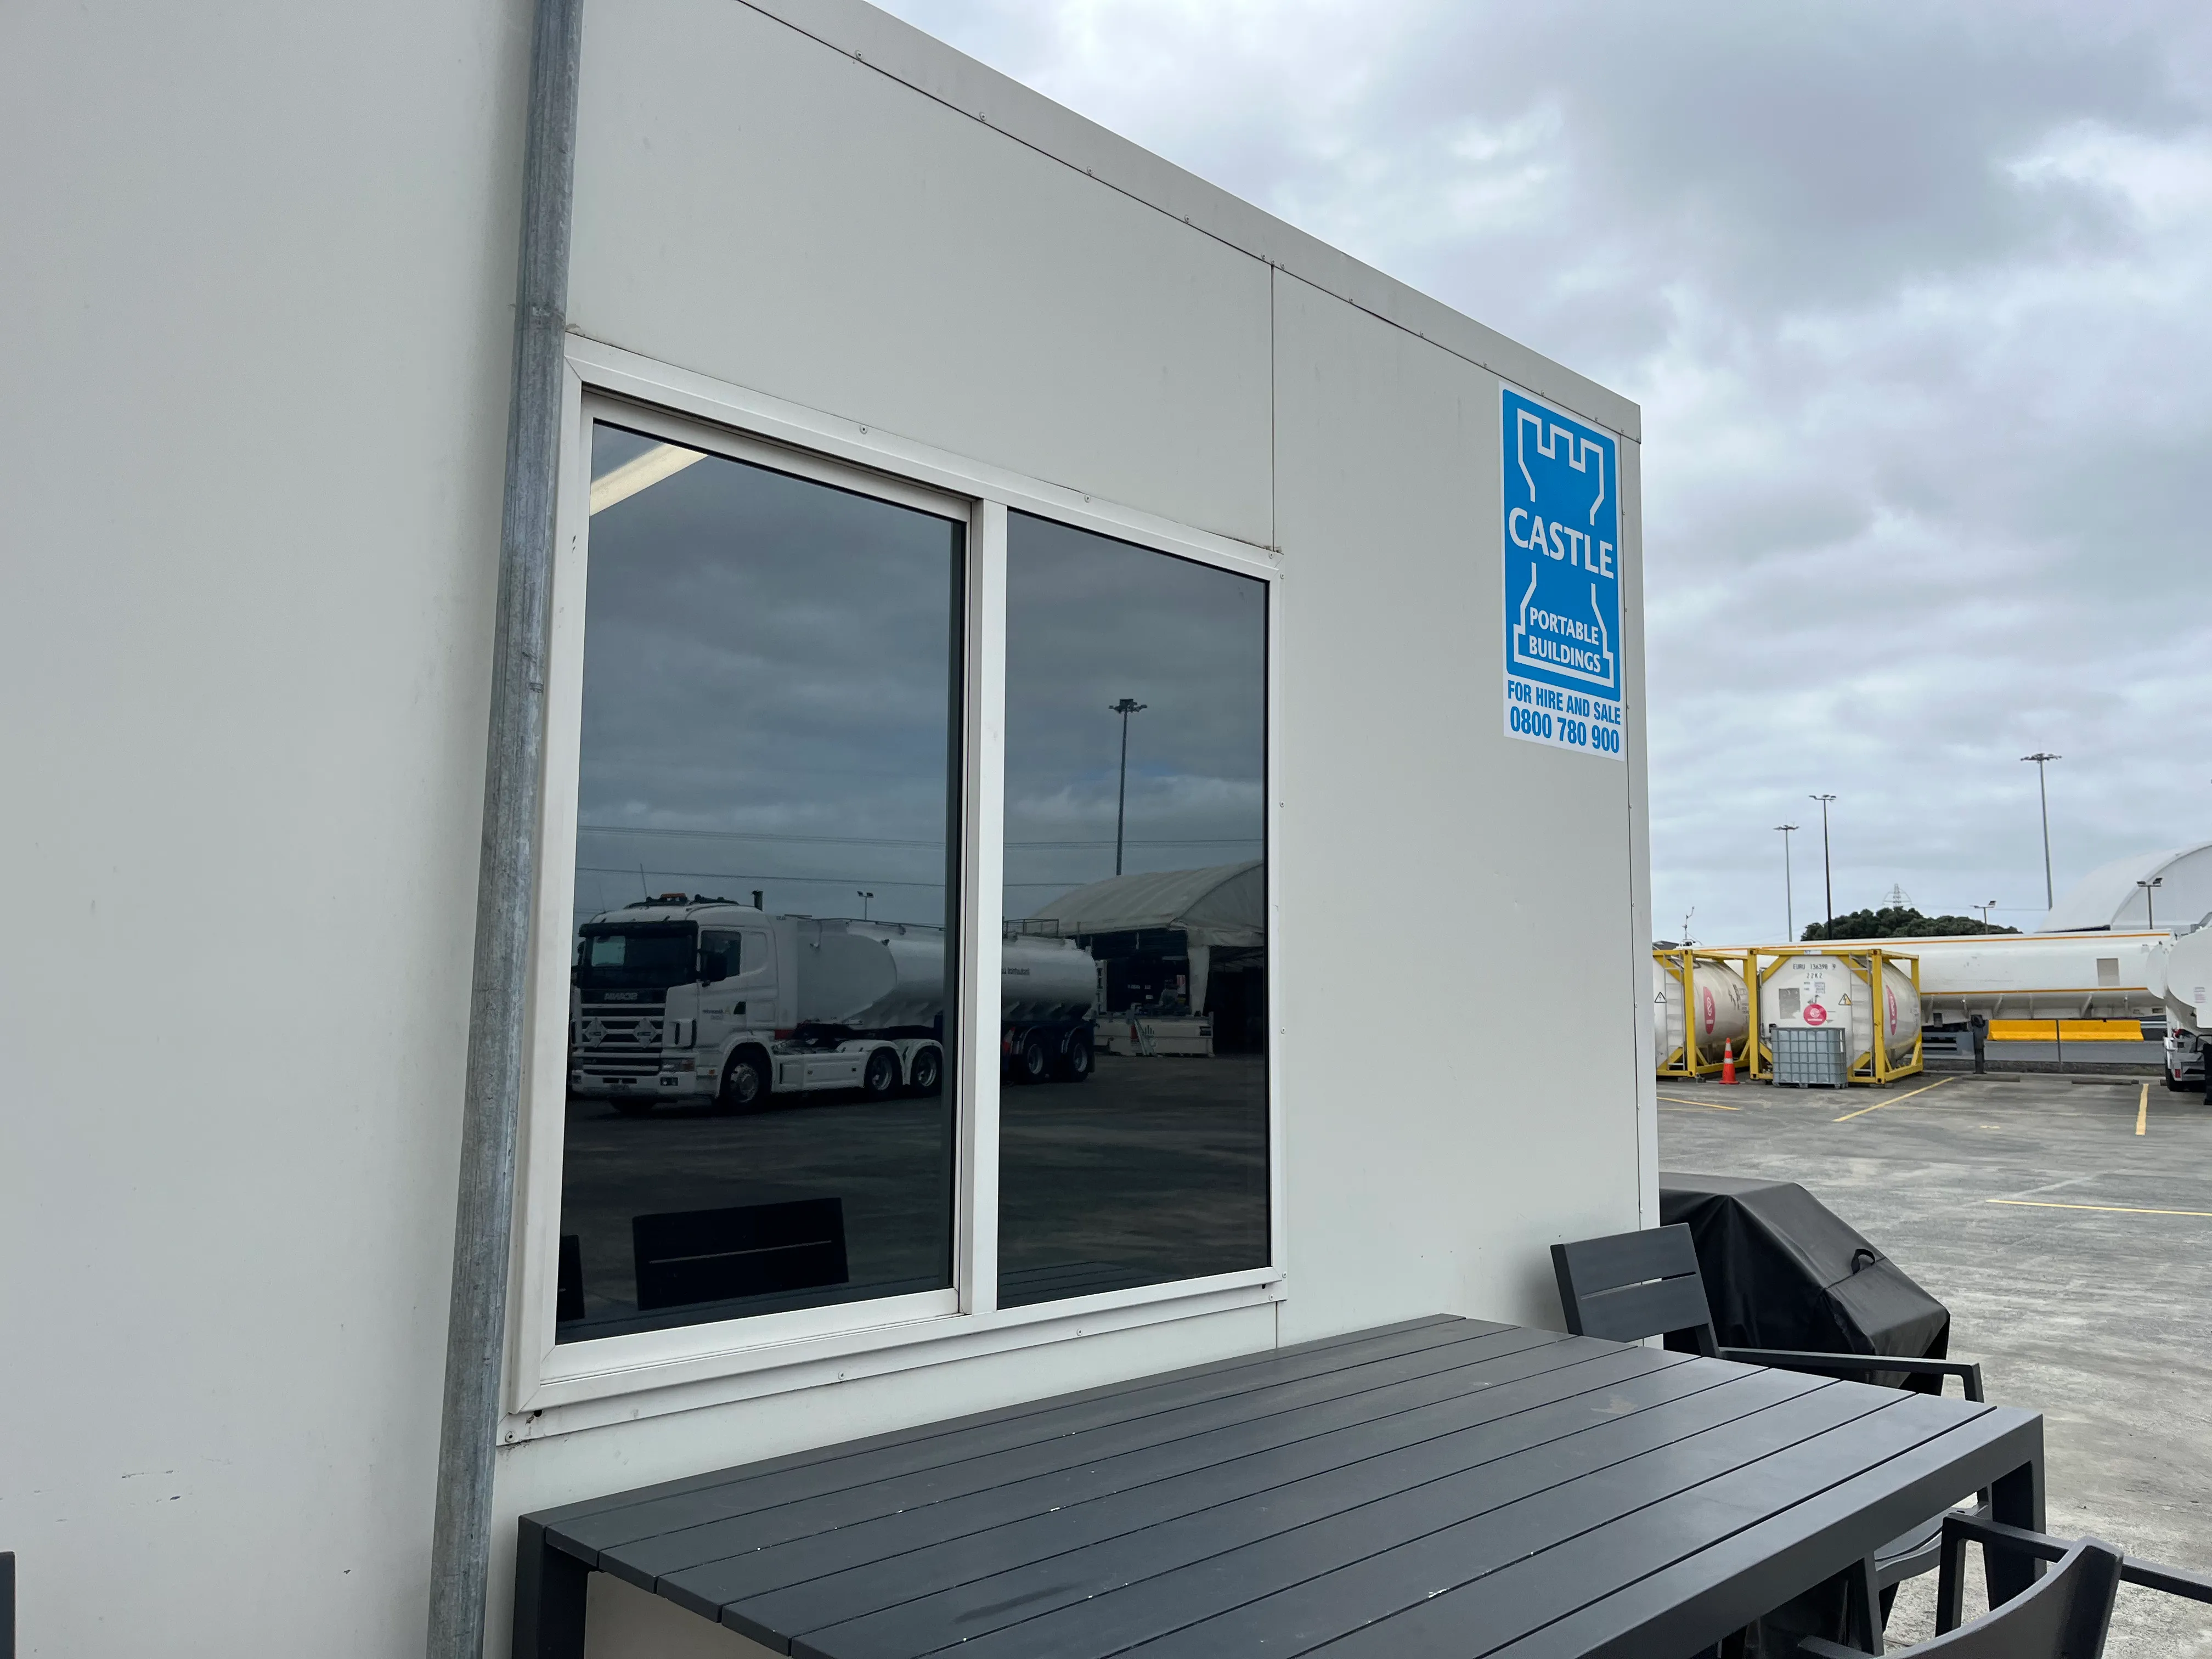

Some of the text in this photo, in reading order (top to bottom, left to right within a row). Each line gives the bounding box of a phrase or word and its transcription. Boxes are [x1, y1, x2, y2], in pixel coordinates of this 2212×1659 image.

[1509, 507, 1614, 579] CASTLE
[1530, 607, 1599, 645] PORTABLE
[1529, 635, 1601, 673] BUILDINGS
[1508, 680, 1621, 725] FOR HIRE AND SALE
[1510, 706, 1619, 753] 0800 780 900
